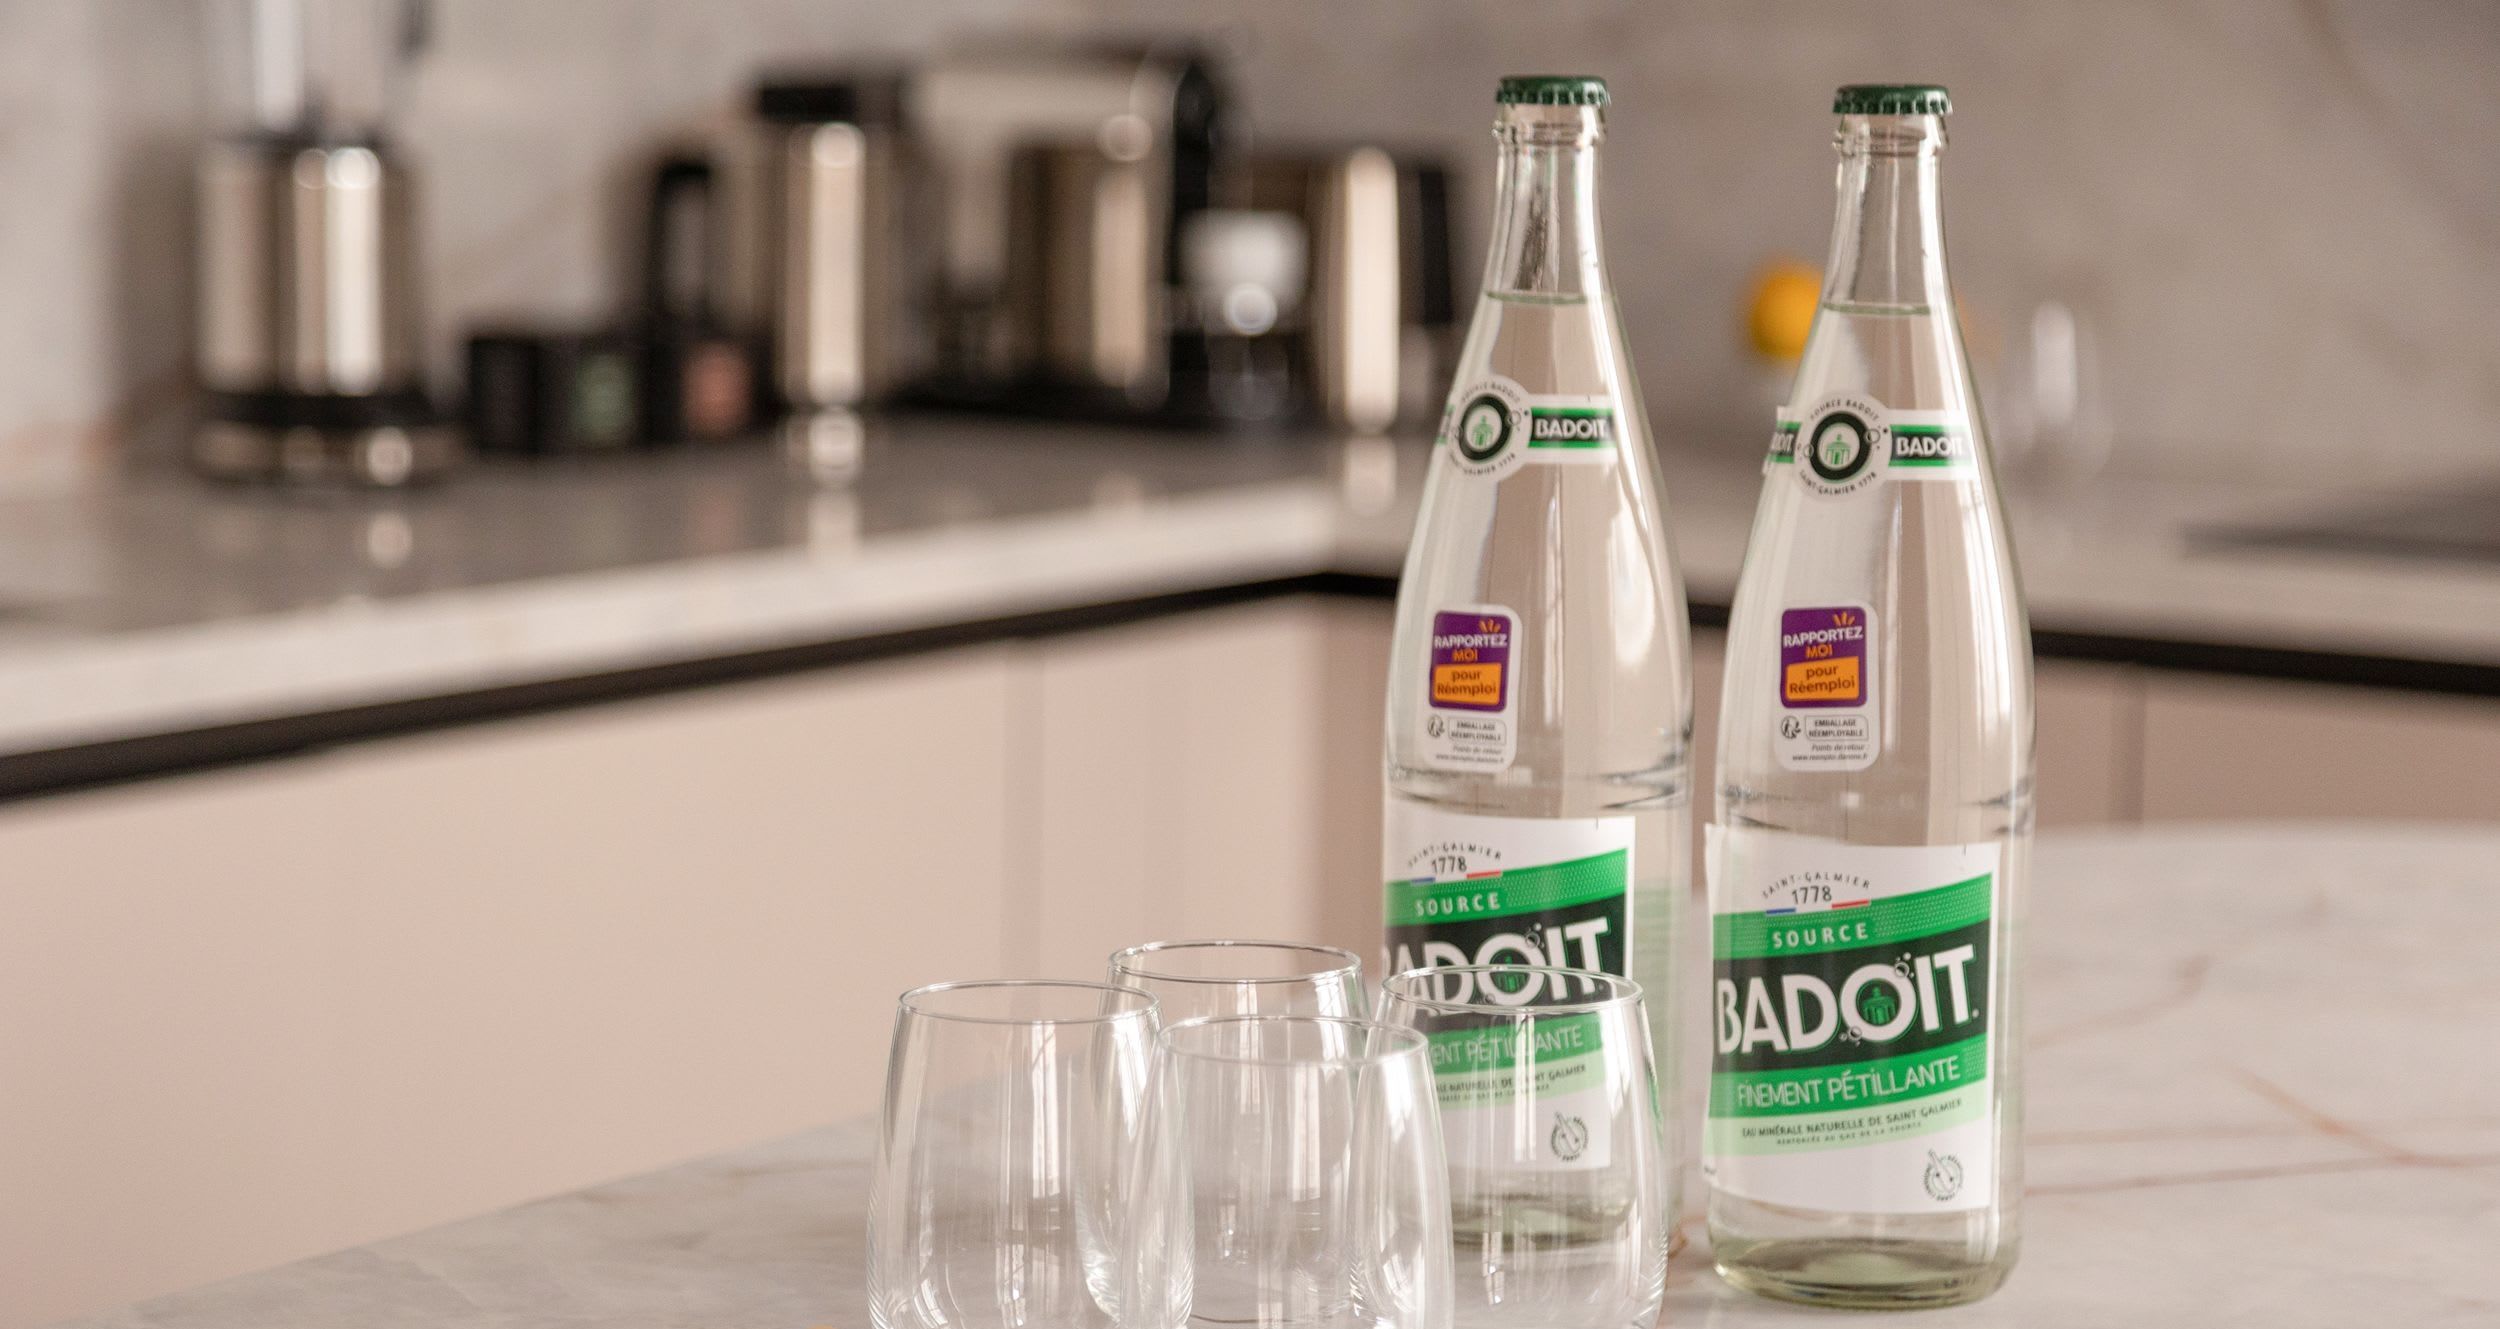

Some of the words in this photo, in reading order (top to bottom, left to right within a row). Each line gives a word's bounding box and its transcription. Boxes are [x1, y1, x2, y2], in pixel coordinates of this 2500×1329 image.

[1535, 418, 1608, 439] BADOIT
[1896, 436, 1964, 457] BADOIT
[1434, 633, 1508, 648] RAPPORTEZ
[1783, 626, 1864, 647] RAPPORTEZ
[1452, 648, 1478, 661] MOI
[1805, 644, 1833, 658] MOI
[1452, 671, 1482, 682] pour
[1806, 666, 1838, 680] pour
[1437, 682, 1497, 696] Réemploi
[1789, 675, 1855, 694] Réemploi
[1431, 856, 1467, 874] 1778
[1415, 892, 1500, 917] SOURCE
[1792, 885, 1832, 905] 1778
[1773, 922, 1869, 949] SOURCE
[1716, 943, 1976, 1054] BADOIT
[1466, 1025, 1584, 1064] PÉTILANTE
[1737, 1078, 1824, 1108] FINEMENT
[1827, 1055, 1961, 1102] PÉTILLANTE
[1806, 1118, 1864, 1133] NATURELLE
[1868, 1116, 1883, 1127] DE
[1886, 1109, 1916, 1123] SAINT
